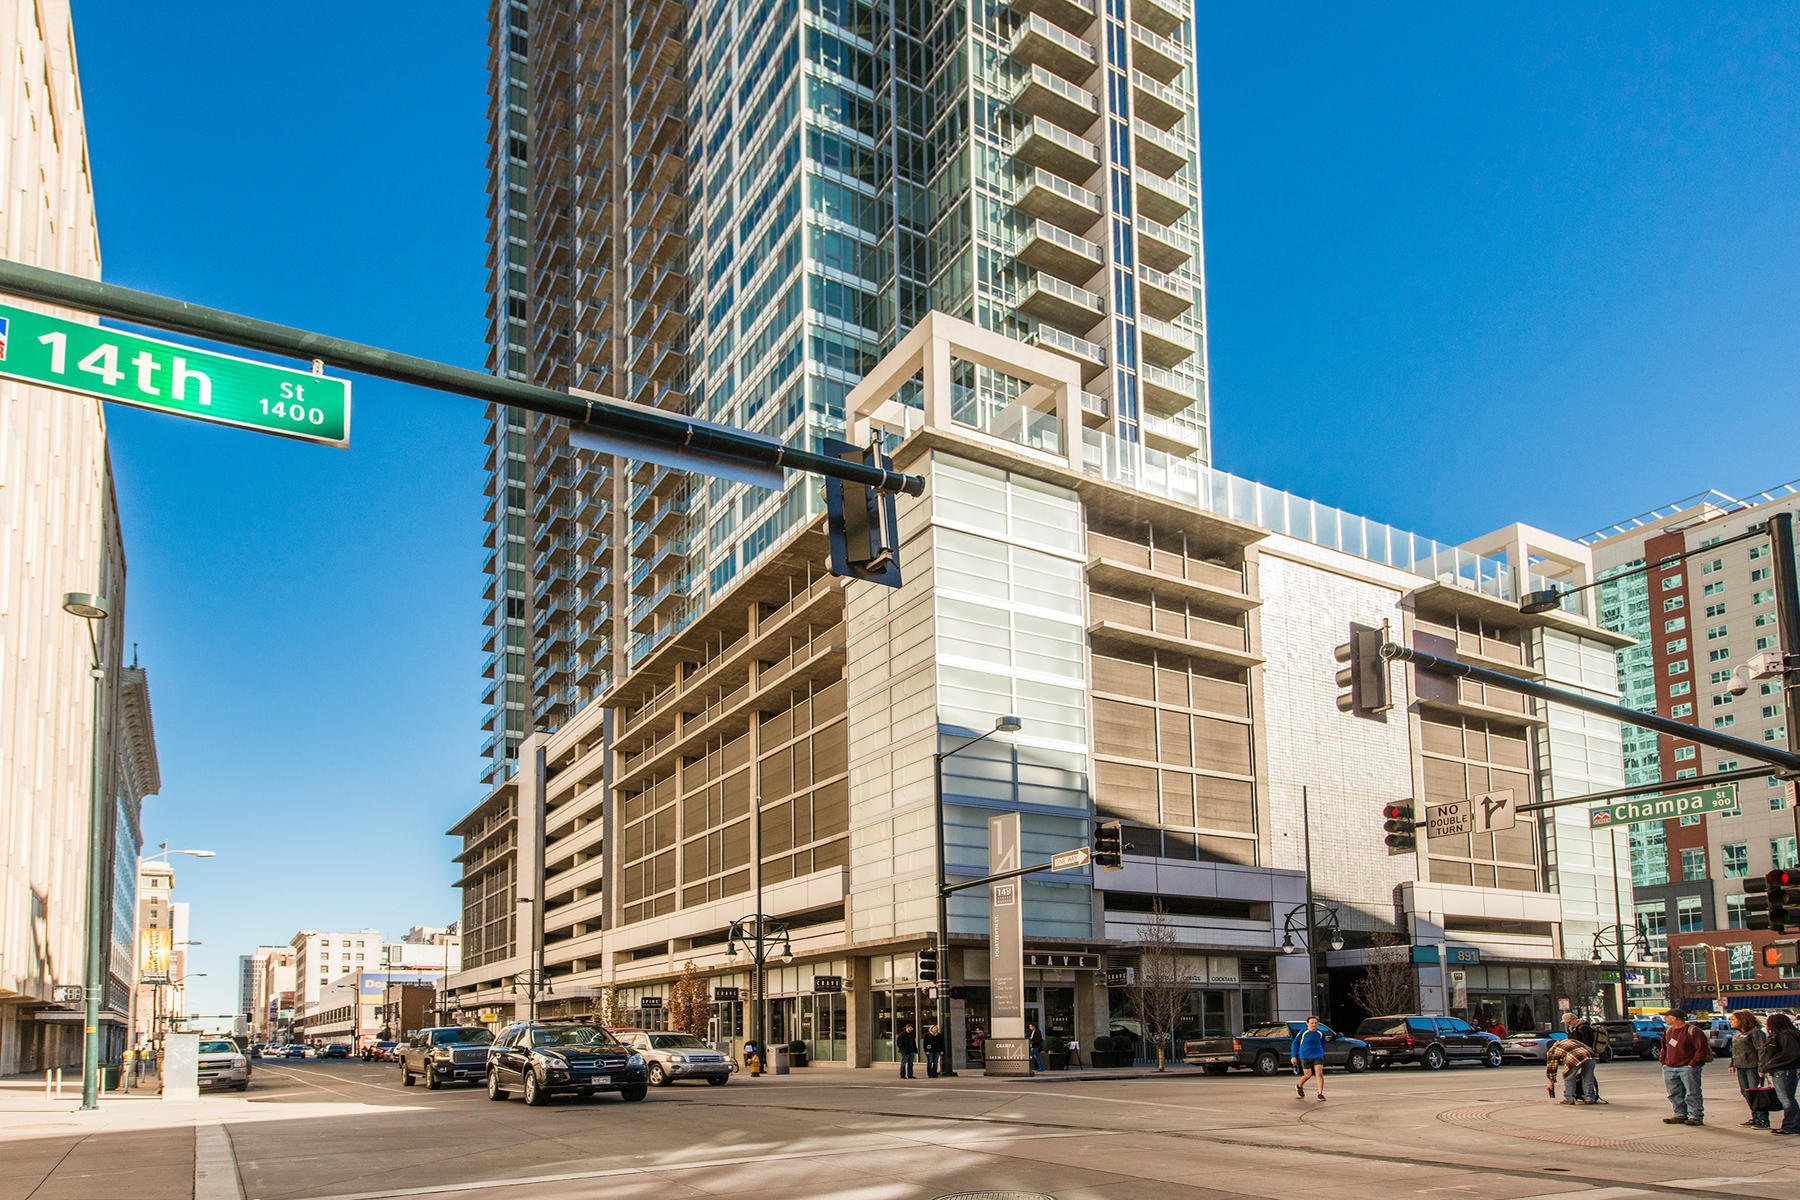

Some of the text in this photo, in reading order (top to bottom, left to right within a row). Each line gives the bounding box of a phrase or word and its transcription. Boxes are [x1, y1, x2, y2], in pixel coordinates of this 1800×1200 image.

[37, 331, 213, 406] 14th
[279, 382, 305, 402] St
[259, 398, 325, 426] 1400
[1716, 791, 1726, 799] St
[1615, 795, 1704, 820] Champa
[1711, 798, 1731, 808] 900
[1437, 804, 1459, 817] NO
[1430, 814, 1468, 828] DOUBLE
[1436, 825, 1463, 836] TURN
[1056, 855, 1078, 866] ONE WAY
[1031, 955, 1084, 967] RAVE
[1457, 950, 1477, 961] 891
[1696, 984, 1730, 992] STOUT
[1746, 982, 1789, 991] SOCIAL
